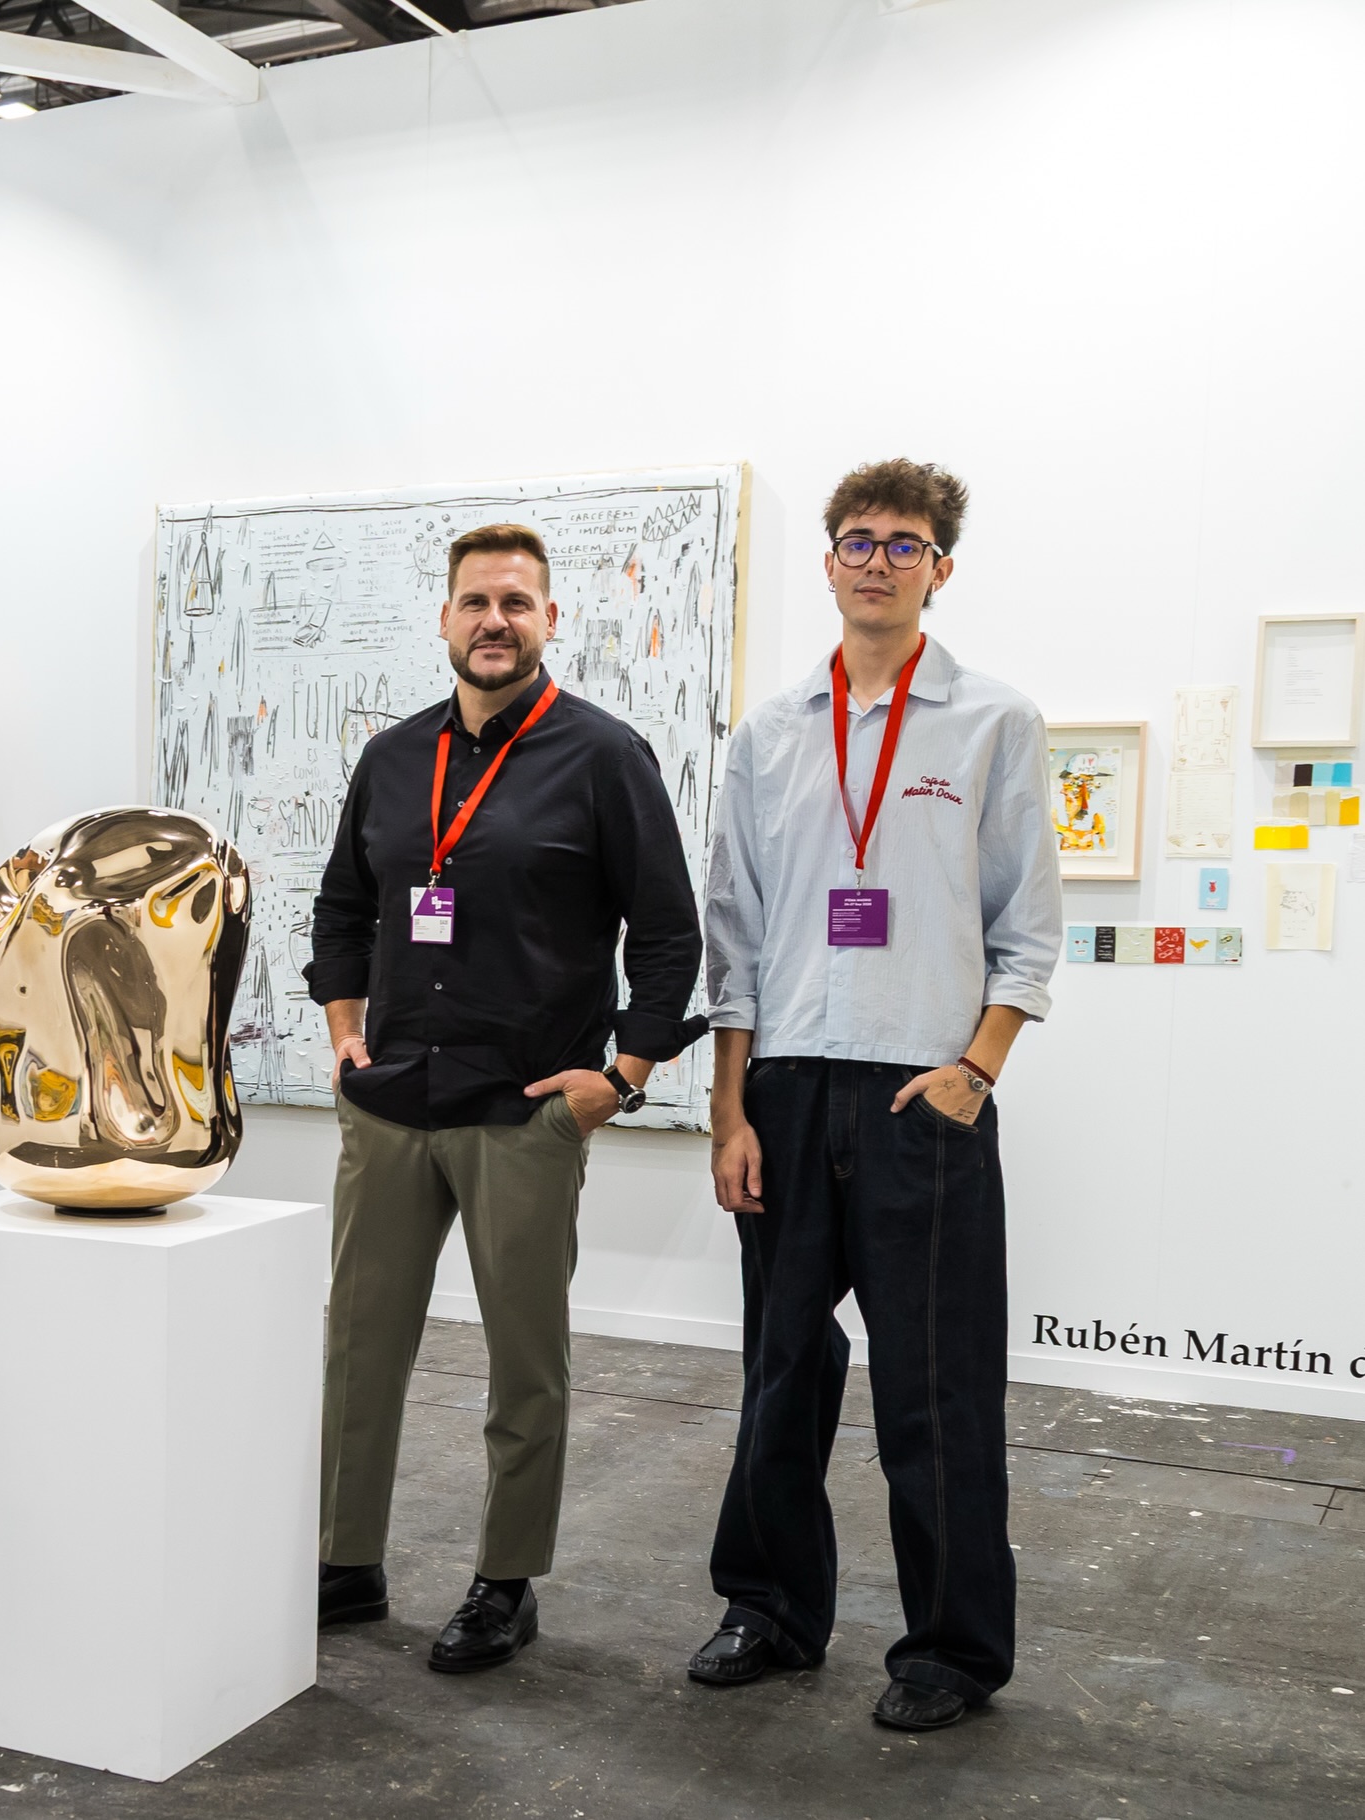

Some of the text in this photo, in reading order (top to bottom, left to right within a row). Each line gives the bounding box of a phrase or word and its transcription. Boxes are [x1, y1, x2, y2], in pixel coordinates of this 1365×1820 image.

[569, 510, 634, 522] CARCEREM
[292, 663, 304, 676] EL
[306, 748, 319, 764] ES
[293, 765, 321, 780] COMO
[901, 785, 963, 805] Matin Doux
[284, 877, 322, 889] TRIPL
[1031, 1313, 1169, 1359] Rubén
[1181, 1328, 1335, 1376] Martín
